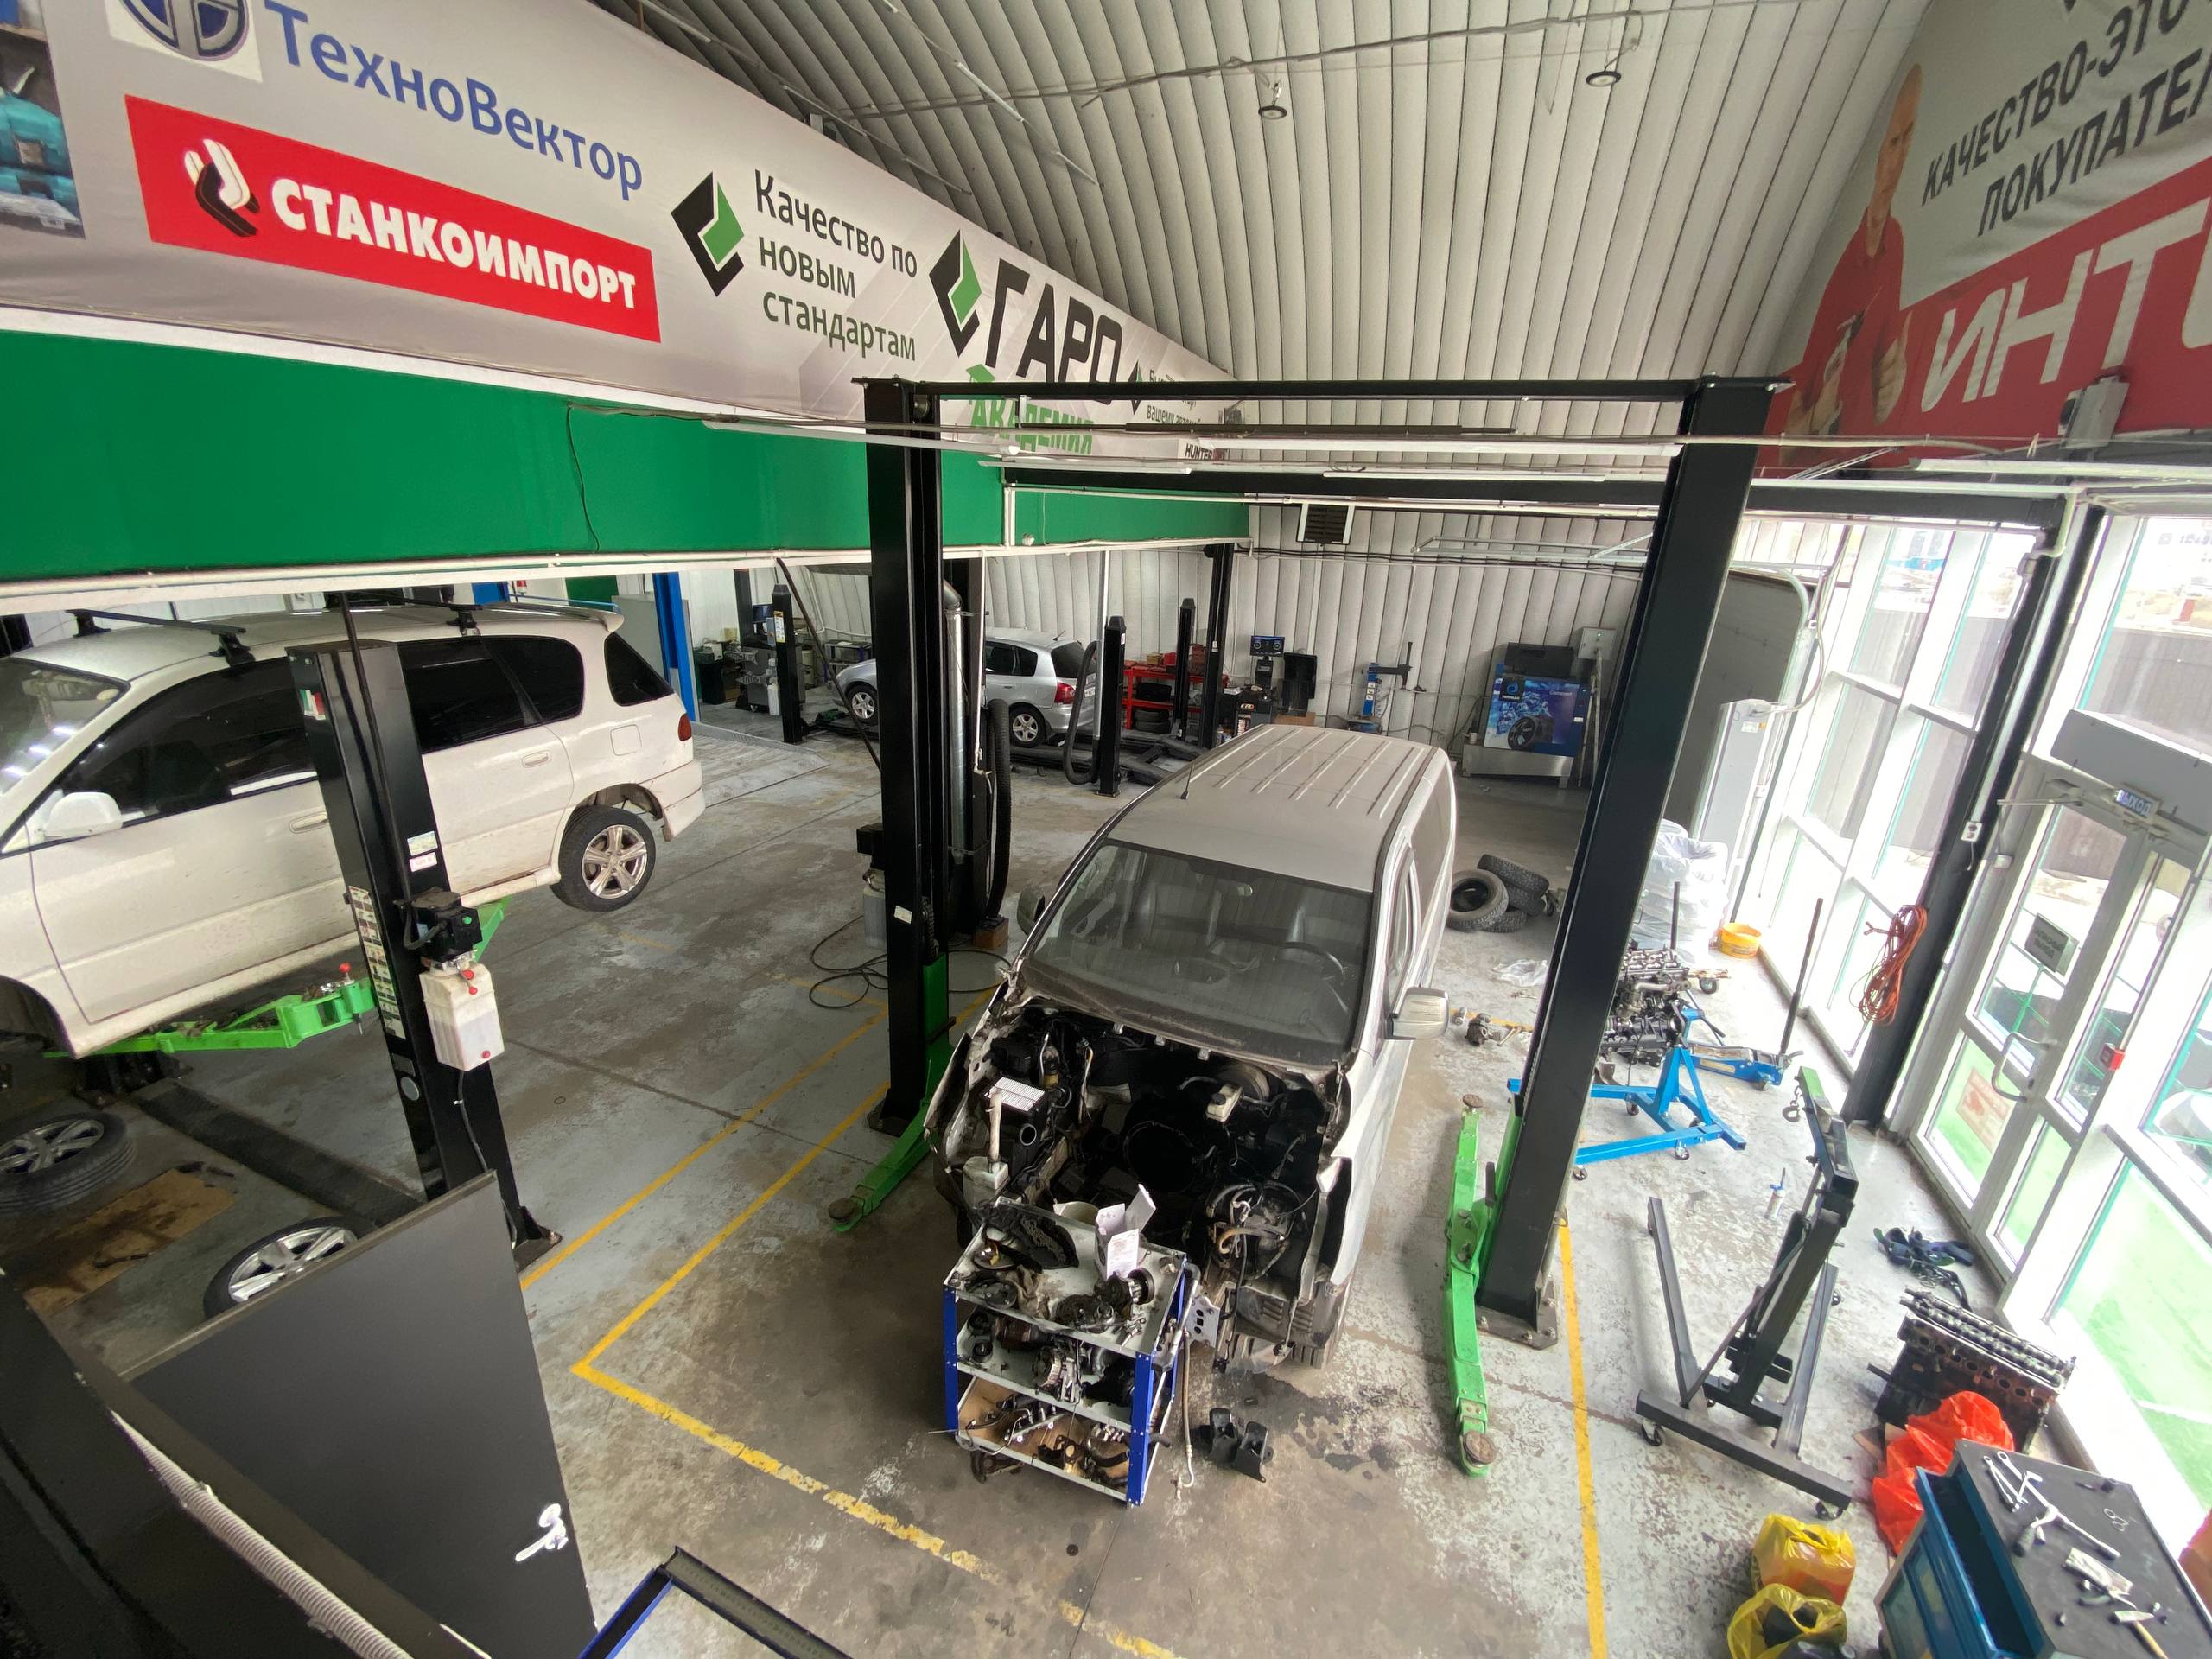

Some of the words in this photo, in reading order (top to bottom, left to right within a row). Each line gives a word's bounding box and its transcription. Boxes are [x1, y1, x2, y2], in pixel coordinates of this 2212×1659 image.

[264, 0, 643, 200] ТехноВектор
[271, 178, 637, 309] СТАНКОИМПОРТ
[754, 168, 885, 264] Качество
[891, 244, 918, 277] по
[758, 236, 856, 299] новым
[764, 291, 916, 362] стандартам
[985, 257, 1122, 405] ГАРО
[1184, 442, 1213, 461] HUNTER
[2115, 789, 2151, 817] ВЫХОД
